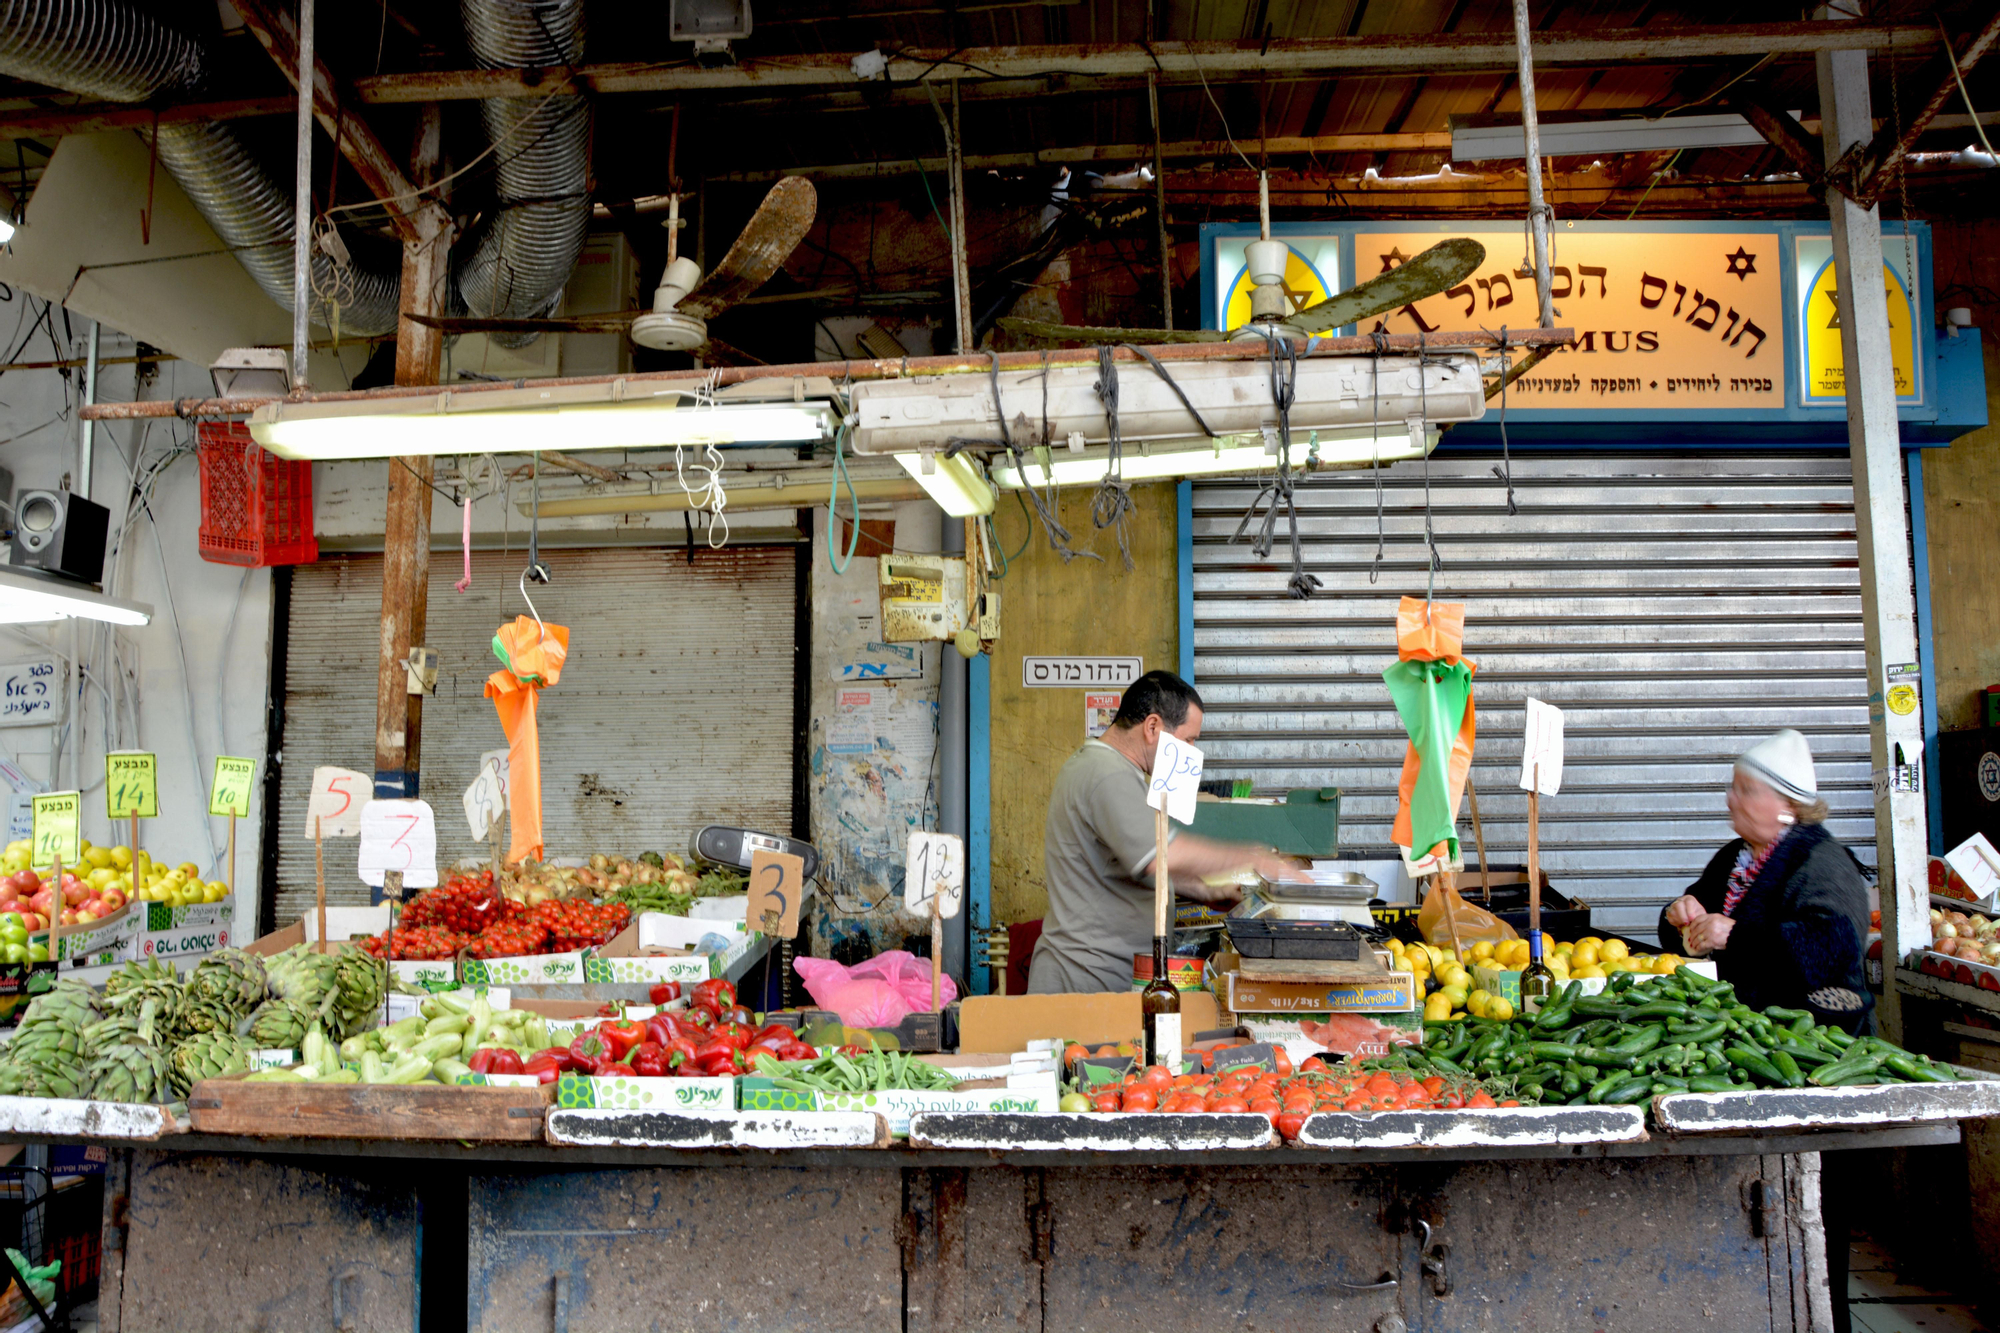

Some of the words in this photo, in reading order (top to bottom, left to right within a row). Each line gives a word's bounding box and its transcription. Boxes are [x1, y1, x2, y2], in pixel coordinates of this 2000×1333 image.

[1640, 271, 1767, 358] חומוס
[1516, 373, 1581, 393] למעדניות
[1590, 377, 1641, 395] והספקה
[1667, 373, 1721, 392] ליחידים
[1730, 378, 1773, 392] מכירה
[1034, 663, 1132, 681] החומוס
[114, 759, 149, 771] מבצע
[222, 763, 249, 773] מבצע
[323, 776, 352, 819] 5
[40, 801, 73, 813] מבצע
[759, 863, 787, 923] 3
[543, 962, 576, 976] מרינה
[669, 963, 703, 977] מרינה
[675, 1086, 723, 1104] מרינה
[886, 1096, 925, 1116] לגליל
